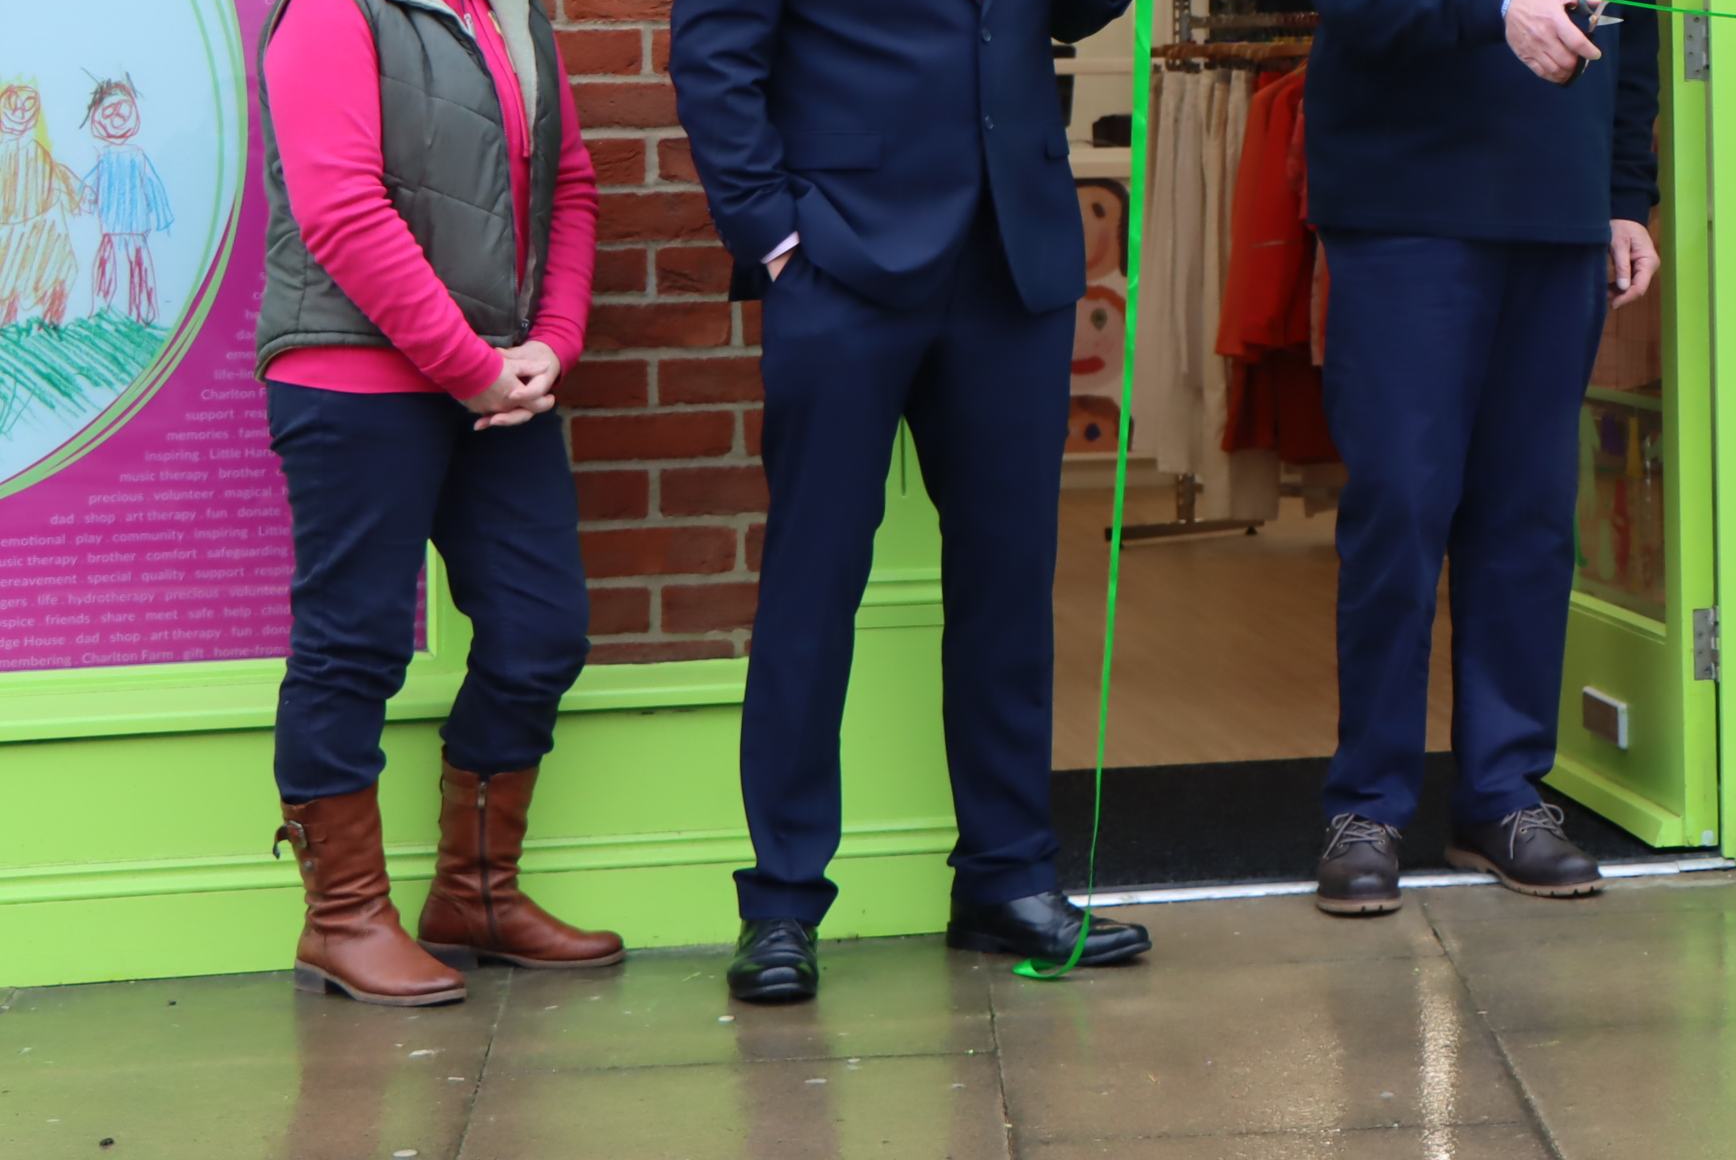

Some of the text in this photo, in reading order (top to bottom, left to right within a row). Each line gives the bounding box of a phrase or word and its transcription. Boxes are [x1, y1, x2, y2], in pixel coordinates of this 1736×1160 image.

[0, 556, 23, 567] usic
[0, 574, 77, 588] ereavement
[0, 655, 72, 667] membering
